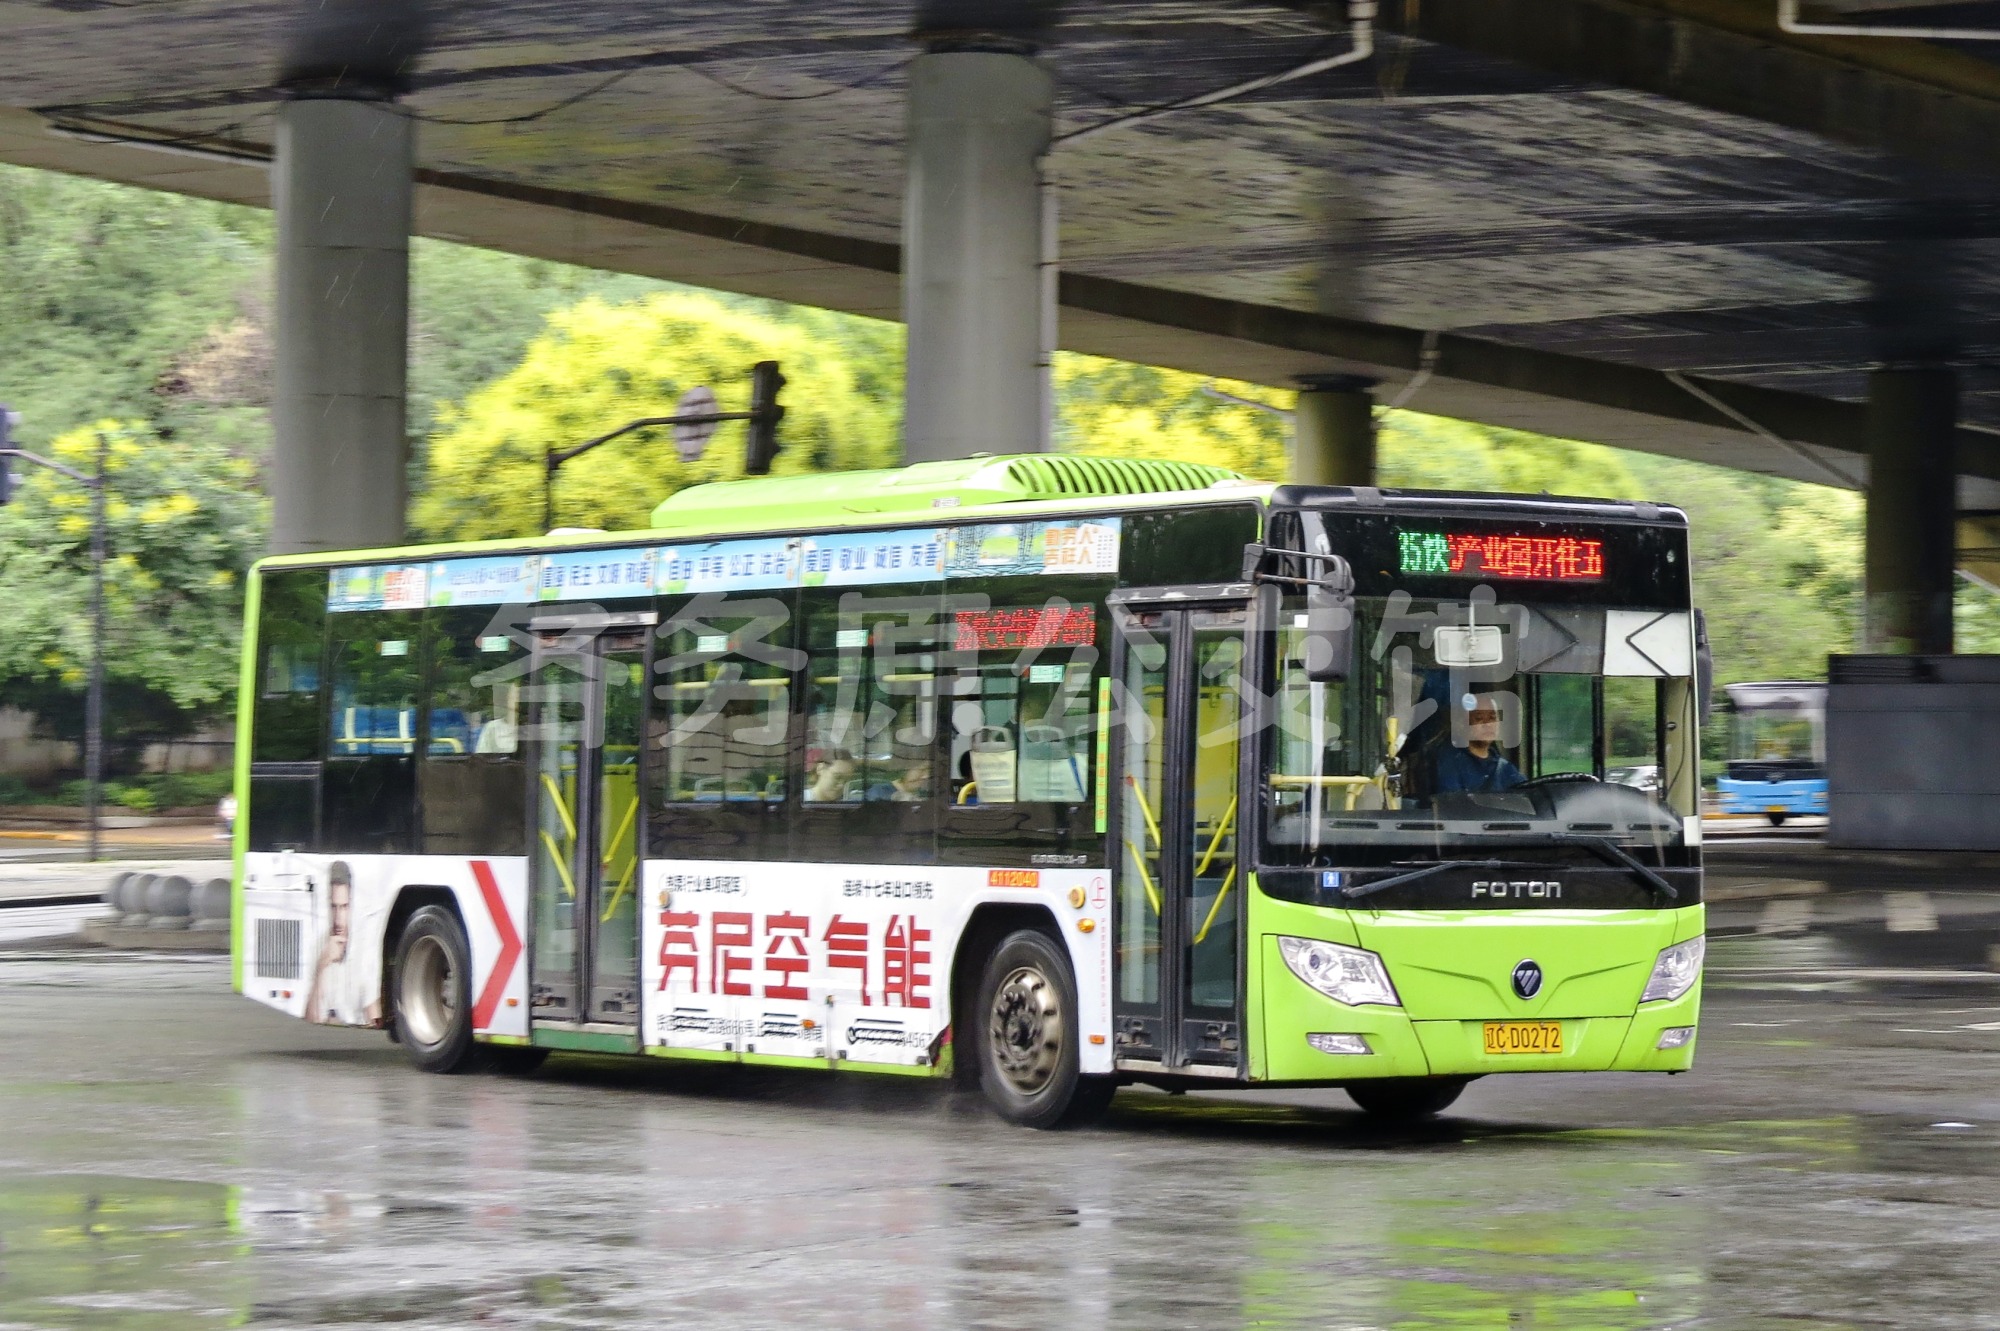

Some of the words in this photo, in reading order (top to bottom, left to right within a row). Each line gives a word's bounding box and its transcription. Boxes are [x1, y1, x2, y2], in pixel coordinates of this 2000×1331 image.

[1471, 880, 1562, 899] FOTON
[657, 909, 932, 1008] 芬尼空气能
